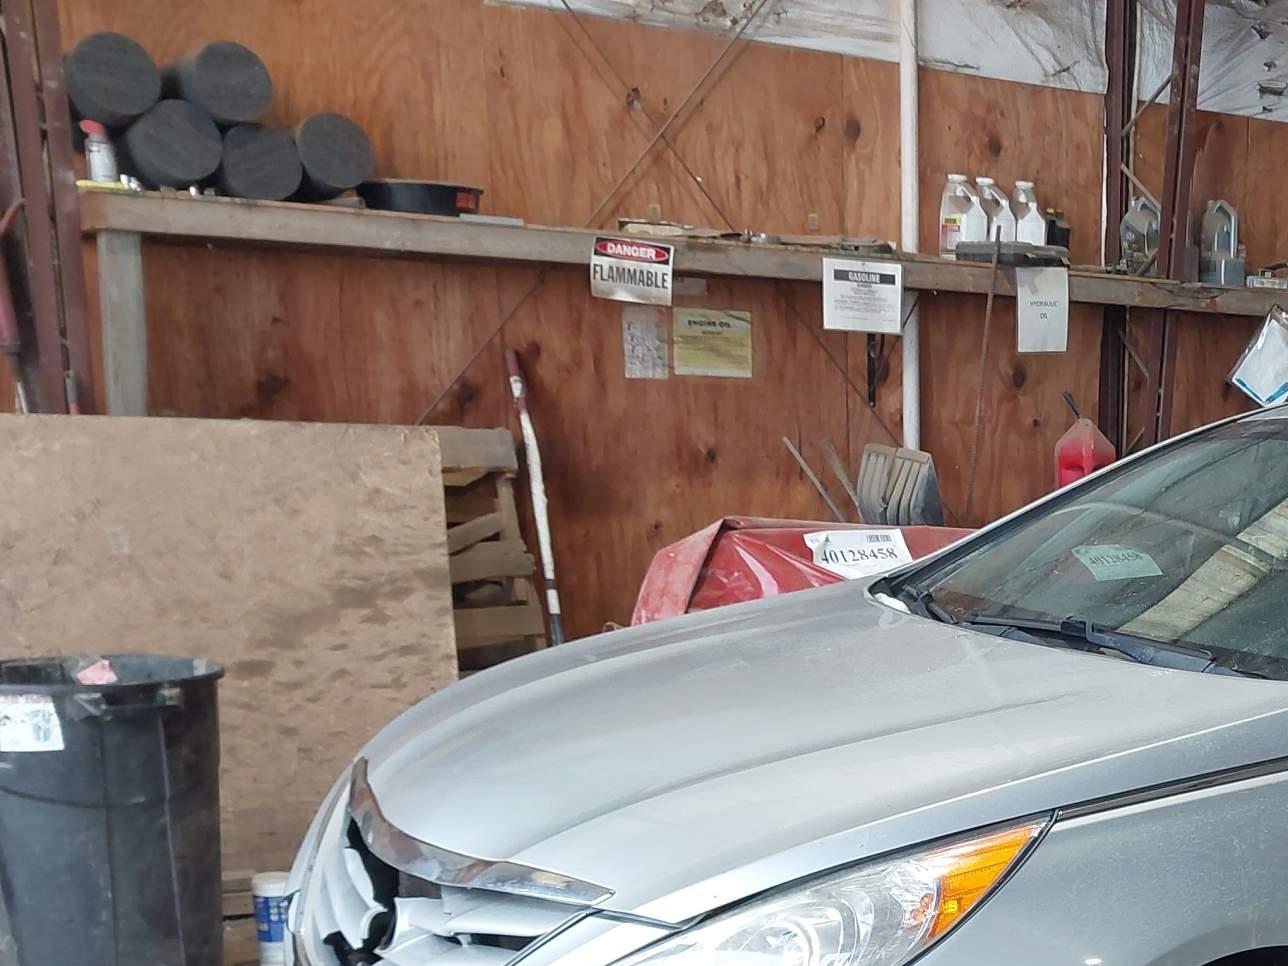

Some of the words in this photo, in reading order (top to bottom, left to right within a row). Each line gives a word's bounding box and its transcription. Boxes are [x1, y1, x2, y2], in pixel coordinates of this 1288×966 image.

[606, 242, 657, 260] DANGER
[593, 263, 669, 290] FLAMMABLE
[848, 271, 881, 283] GASOLINE
[821, 547, 898, 564] 40128458
